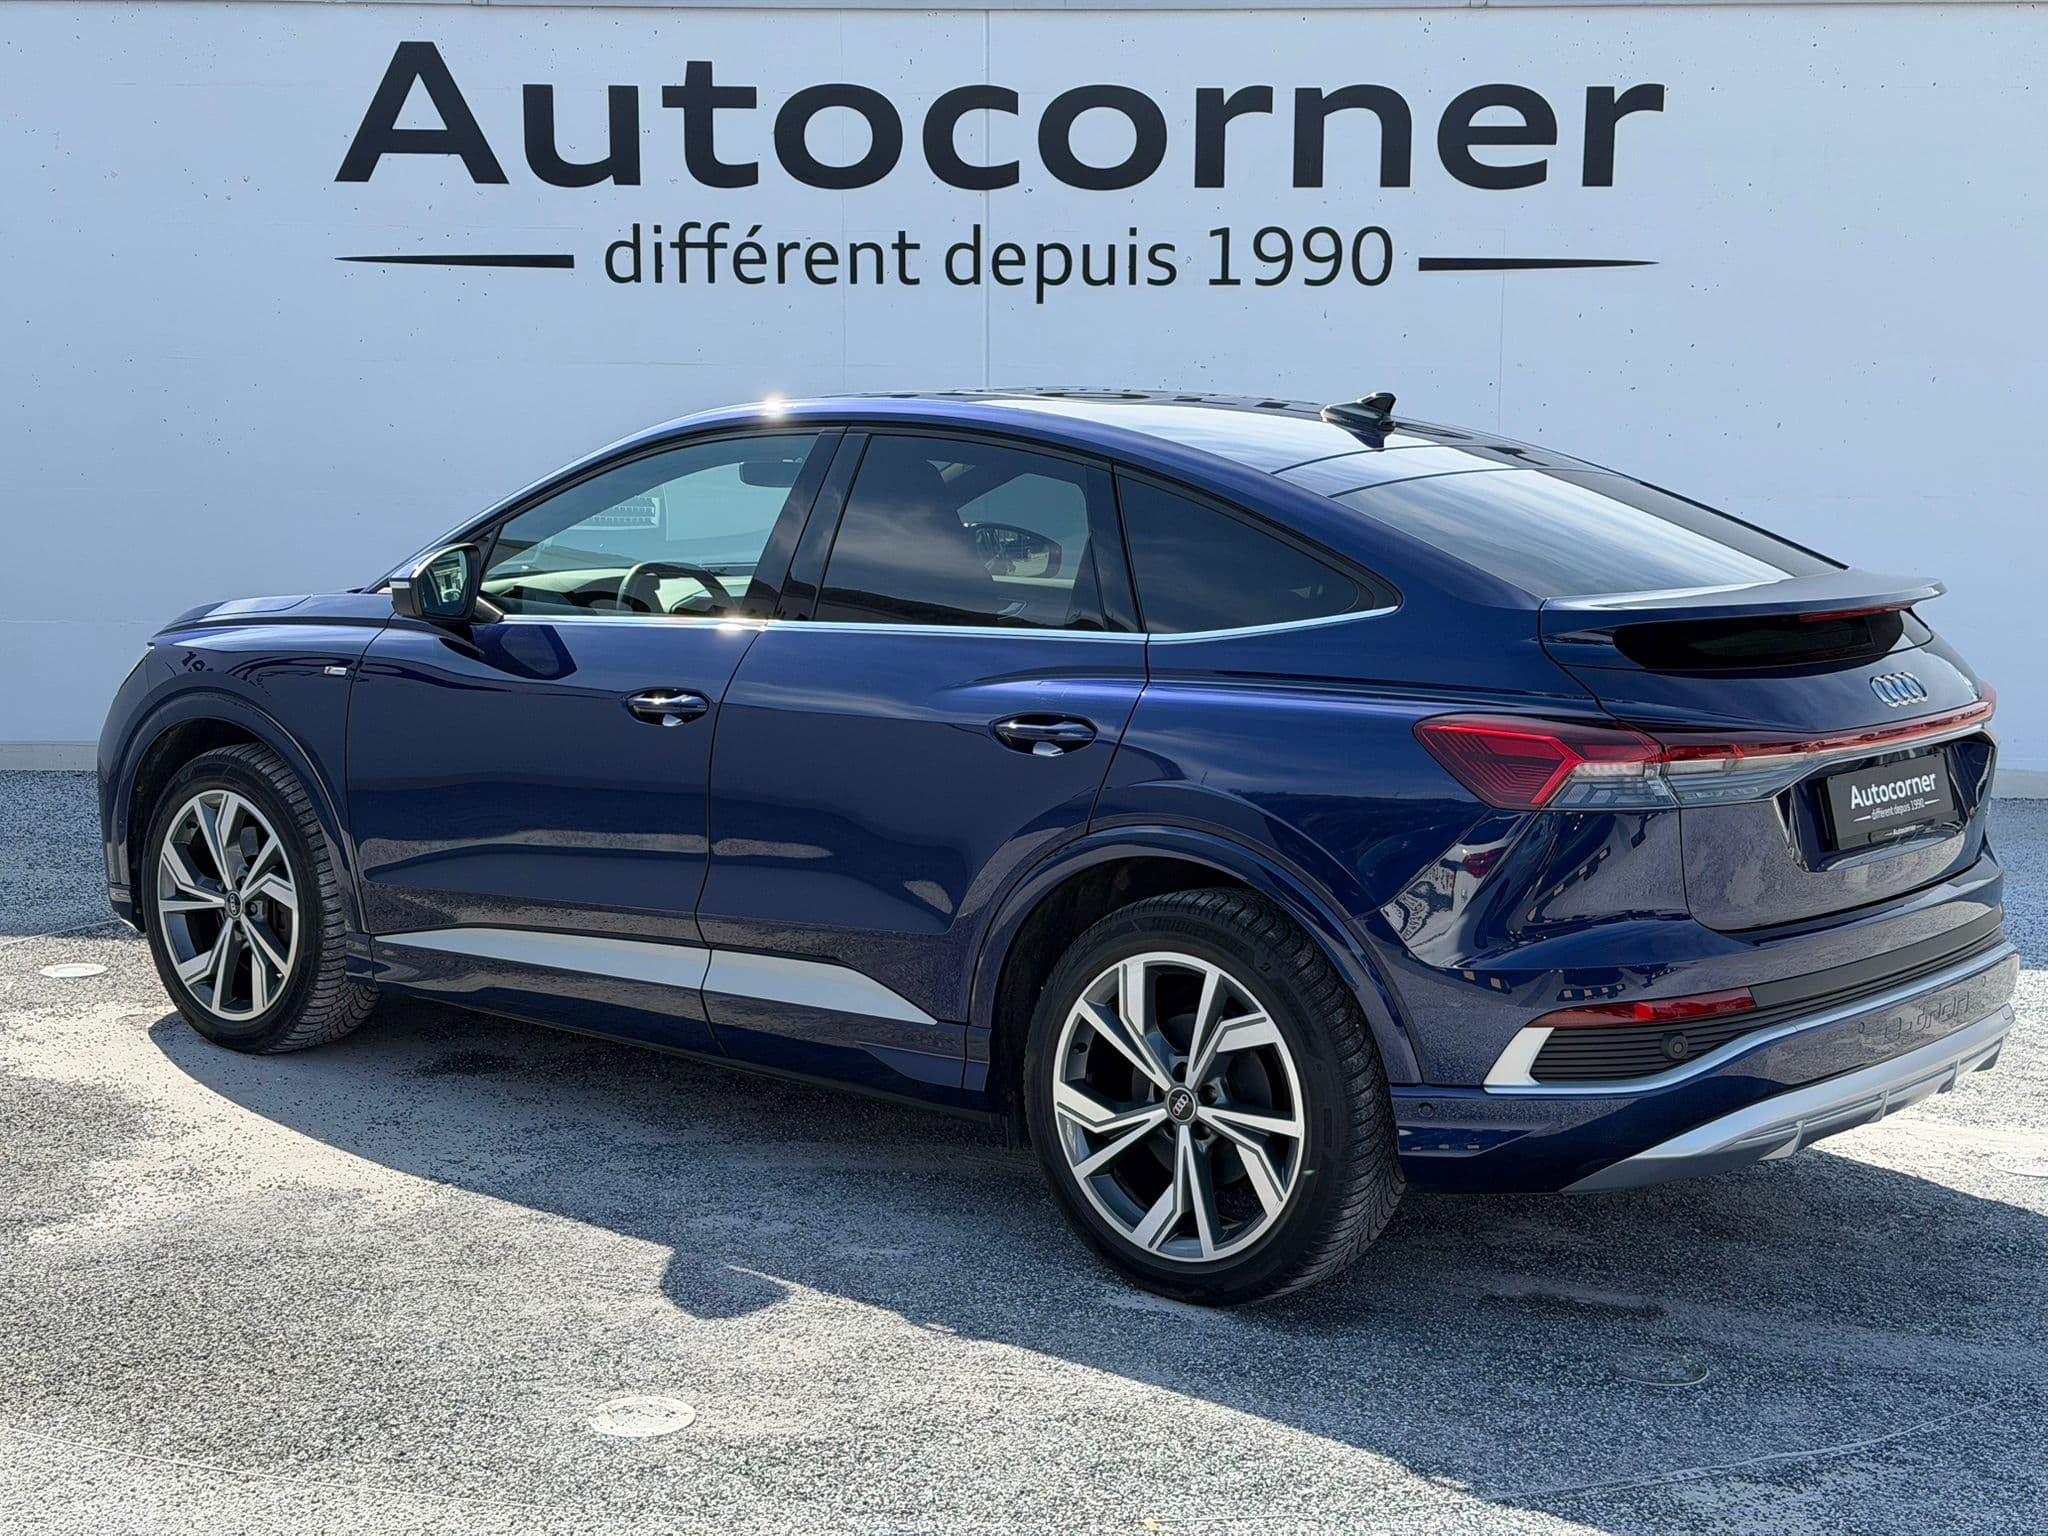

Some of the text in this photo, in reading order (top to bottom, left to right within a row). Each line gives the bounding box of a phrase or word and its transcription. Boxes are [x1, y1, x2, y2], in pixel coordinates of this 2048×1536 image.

[334, 41, 1665, 191] Autocorner
[605, 222, 1392, 304] différent depuis 1990
[1851, 773, 1936, 809] Autocorner
[1910, 797, 1925, 811] 1990
